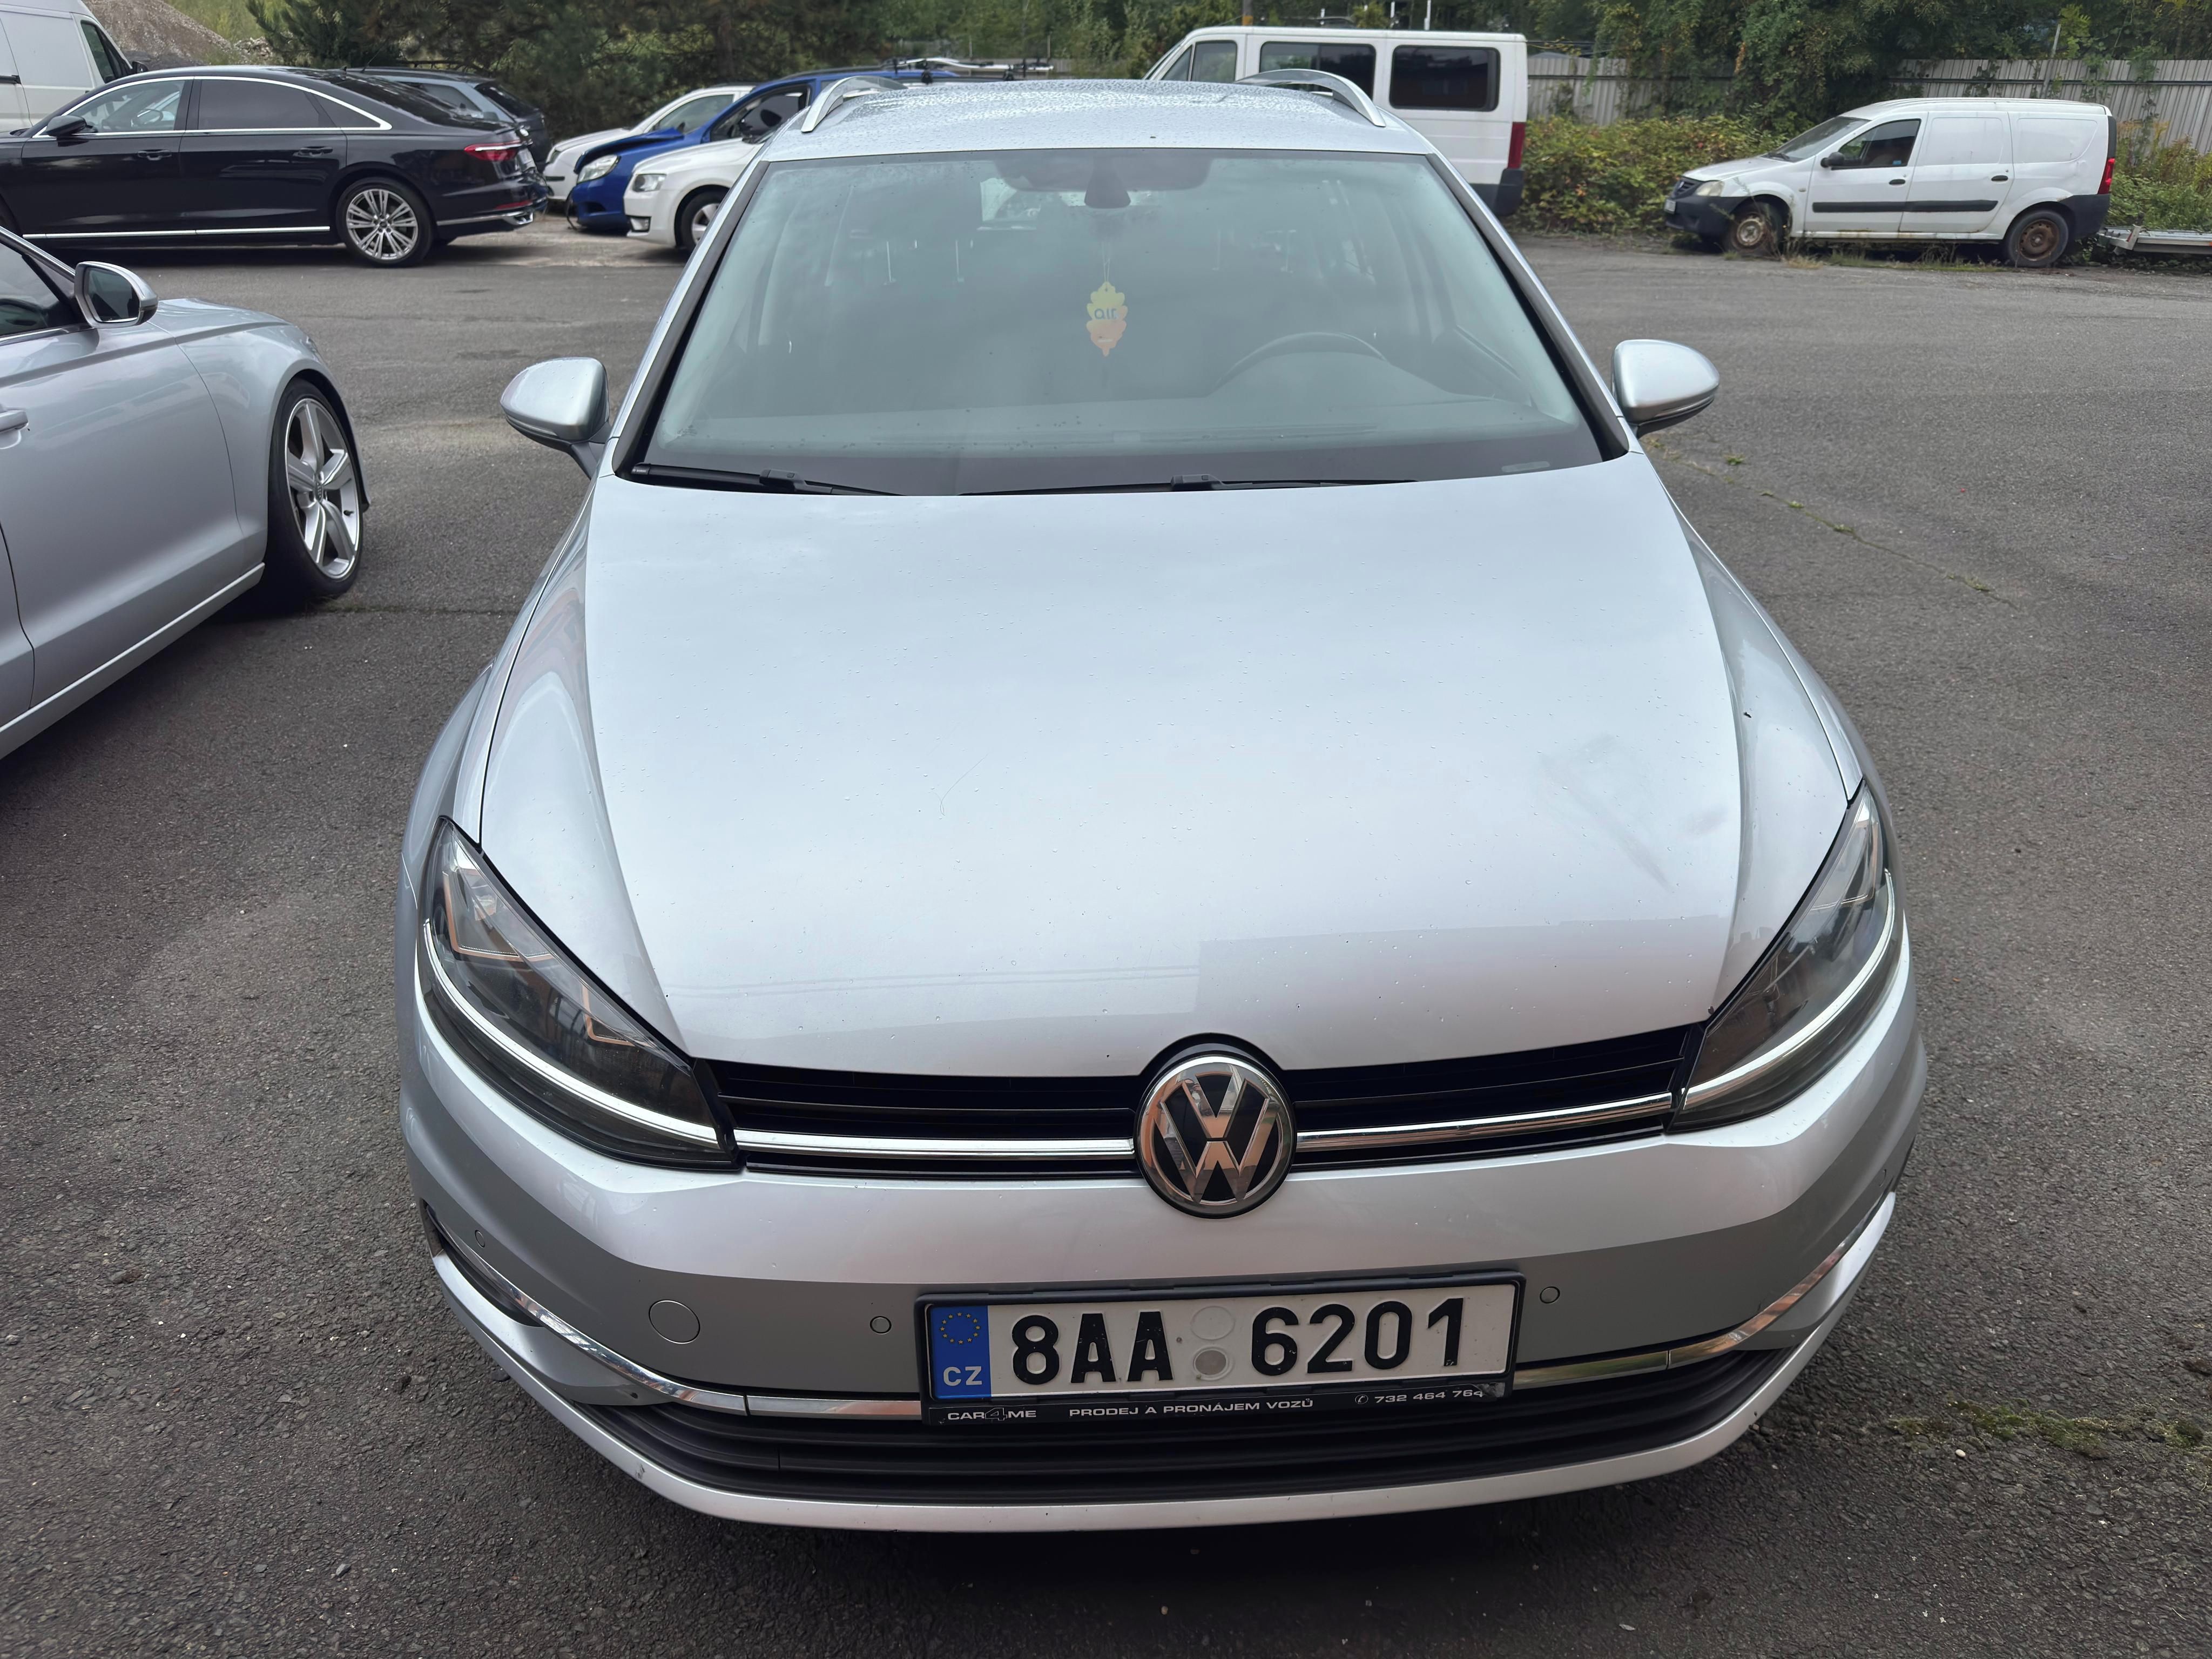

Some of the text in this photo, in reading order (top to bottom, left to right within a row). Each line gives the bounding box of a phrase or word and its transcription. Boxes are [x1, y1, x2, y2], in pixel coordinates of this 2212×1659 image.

[1011, 1297, 1464, 1385] 8AA 6201
[943, 1366, 983, 1386] CZ
[1069, 1407, 1138, 1417] PRODEJ
[1144, 1406, 1157, 1414] A
[1163, 1402, 1260, 1413] PRONÁJEM
[1266, 1398, 1313, 1409] VOZŮ
[1374, 1394, 1407, 1403] 732
[1412, 1391, 1446, 1400] 464
[1452, 1389, 1483, 1398] 764
